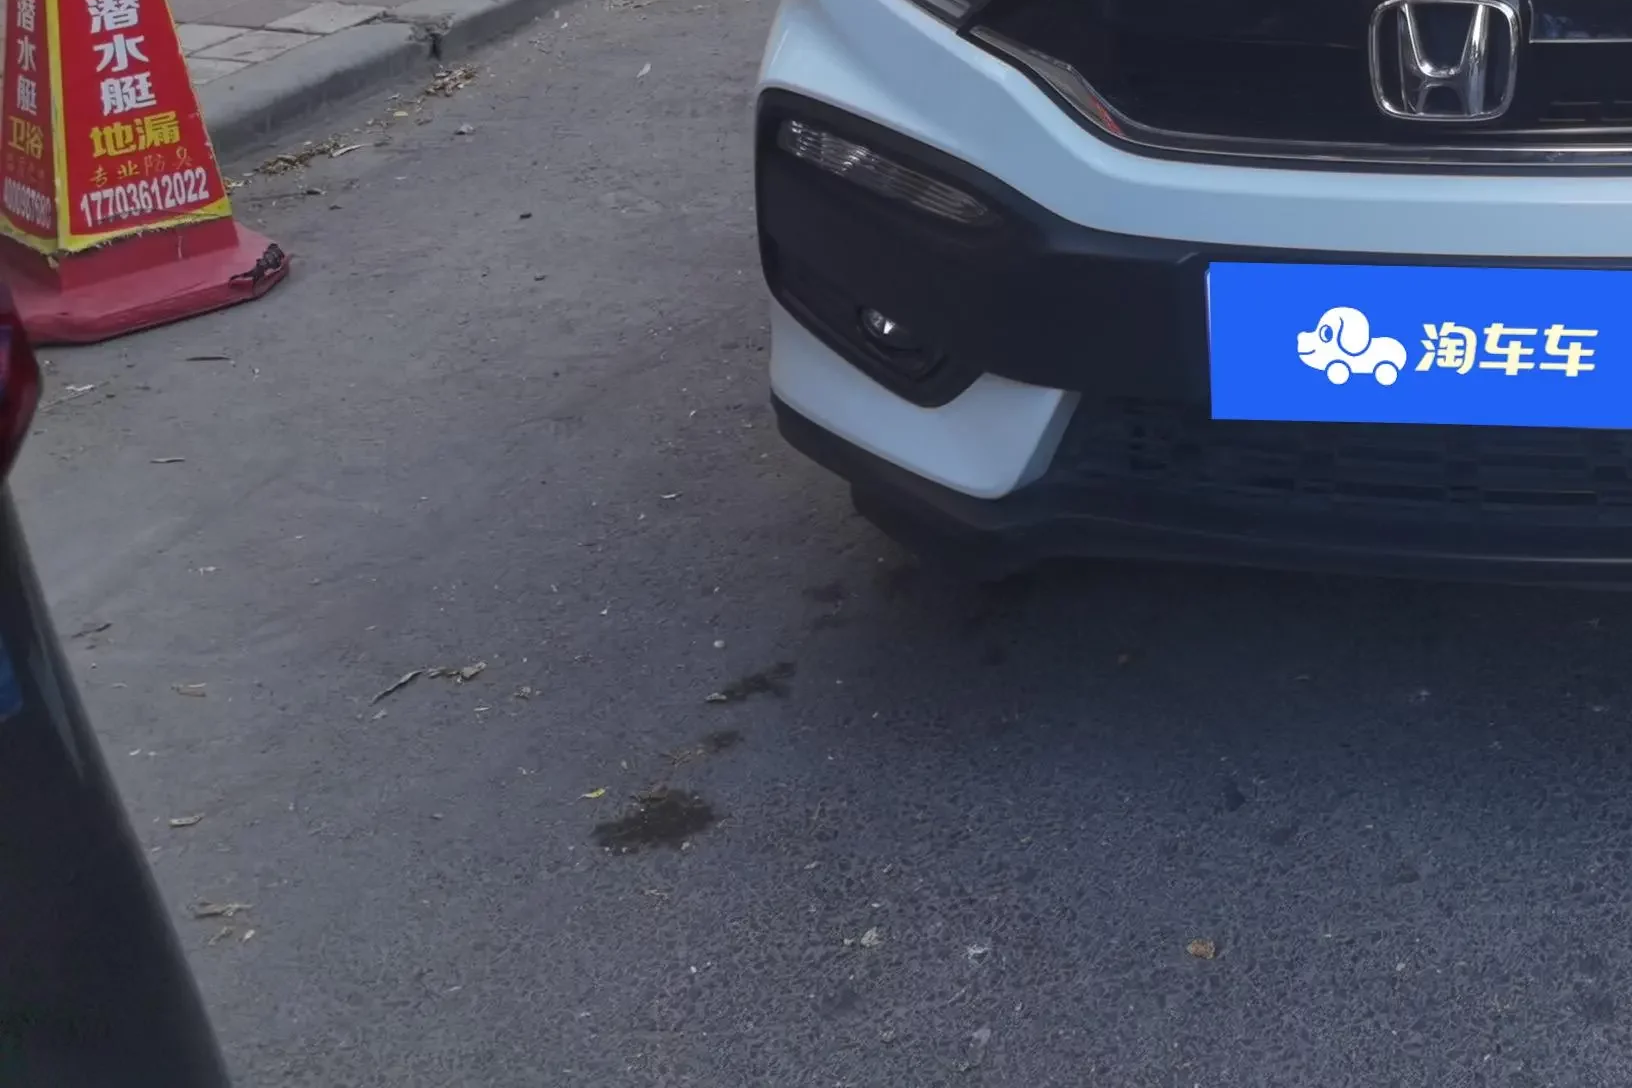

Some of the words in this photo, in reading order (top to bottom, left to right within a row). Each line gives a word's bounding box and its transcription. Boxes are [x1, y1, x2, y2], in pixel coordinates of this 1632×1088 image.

[8, 114, 44, 160] 卫浴
[88, 110, 181, 158] 地漏
[80, 166, 210, 228] 17703612022
